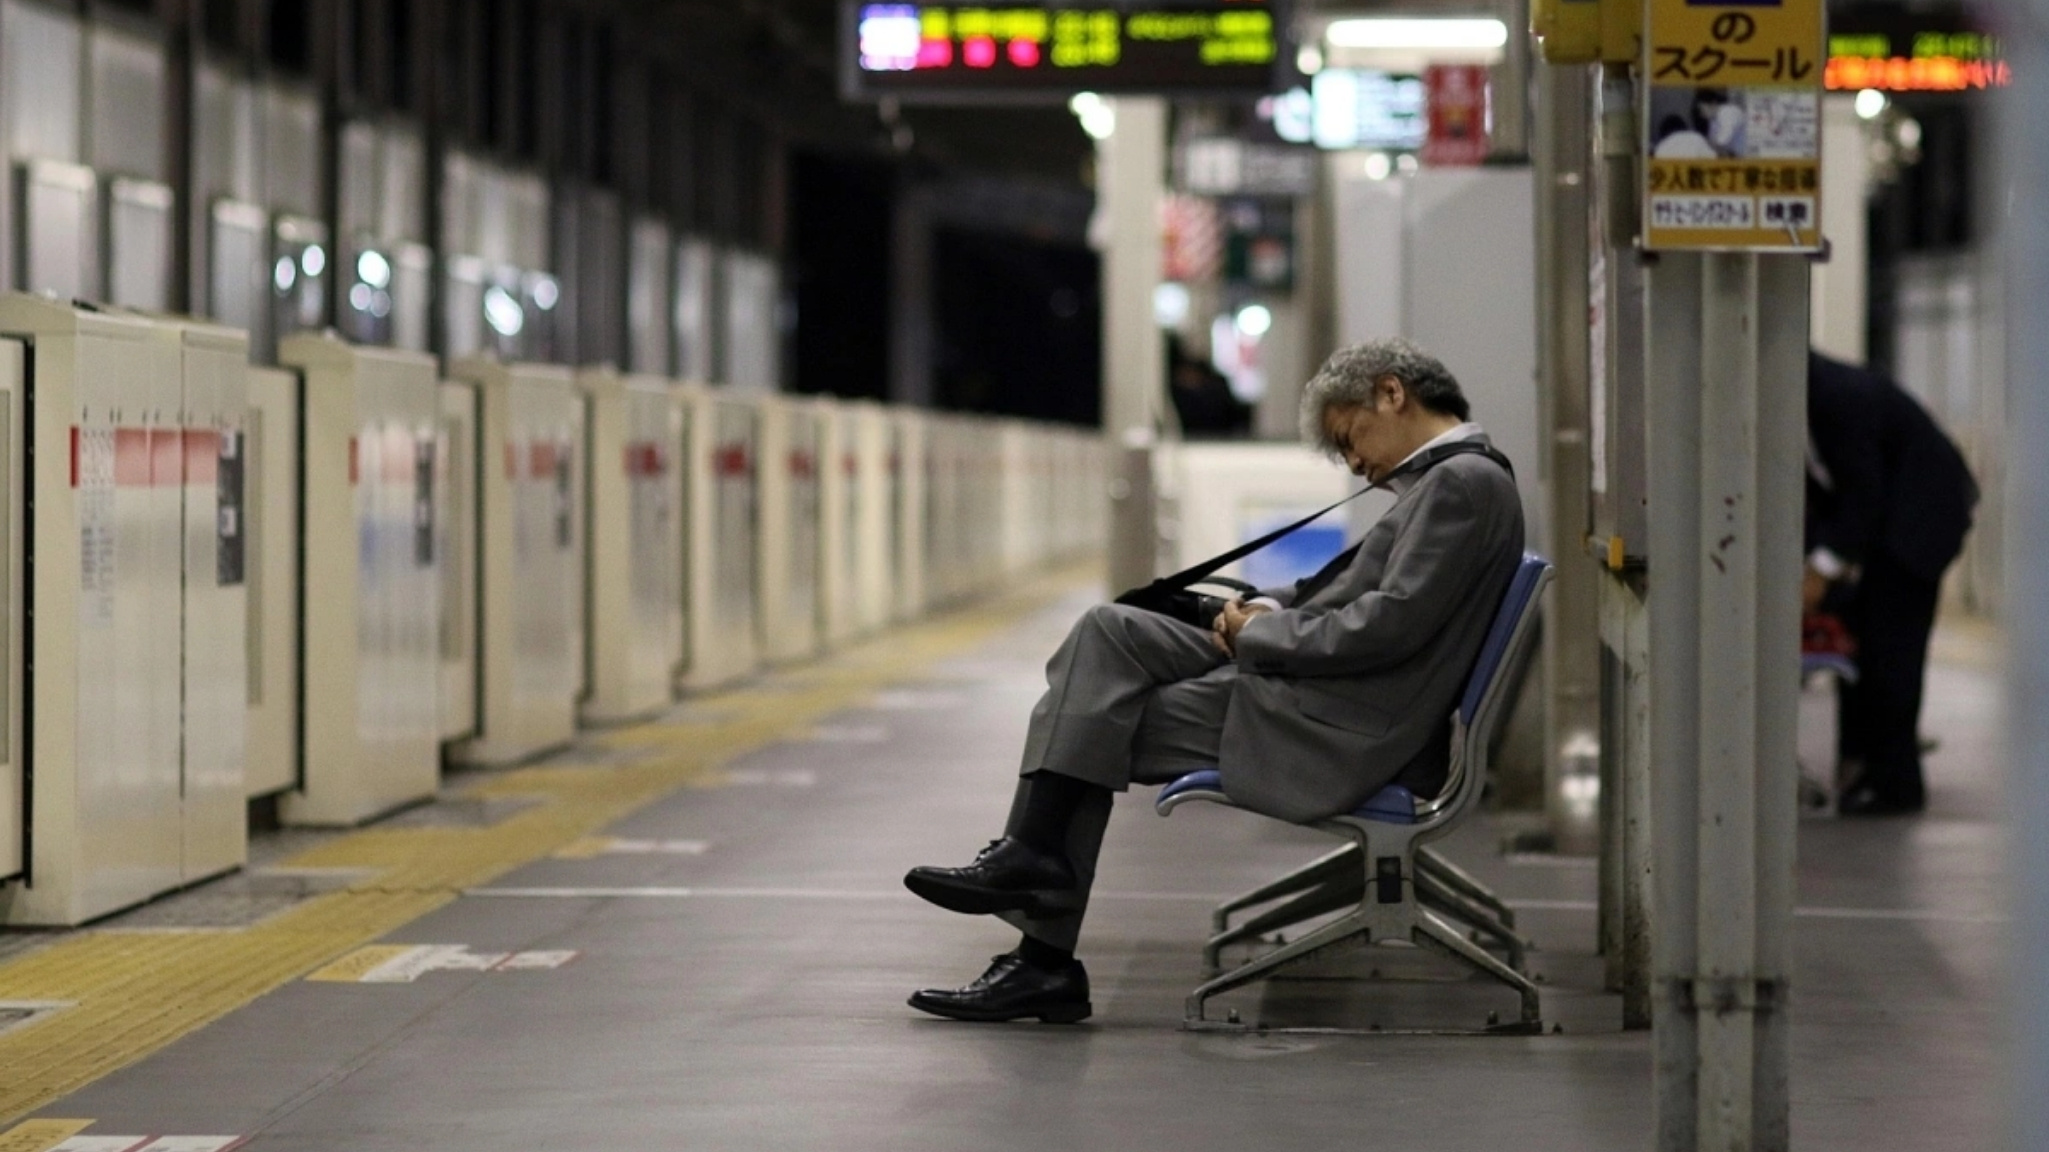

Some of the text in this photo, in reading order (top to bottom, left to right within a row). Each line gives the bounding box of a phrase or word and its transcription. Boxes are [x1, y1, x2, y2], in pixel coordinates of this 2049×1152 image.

[1711, 12, 1756, 43] の
[1654, 46, 1812, 80] スクール
